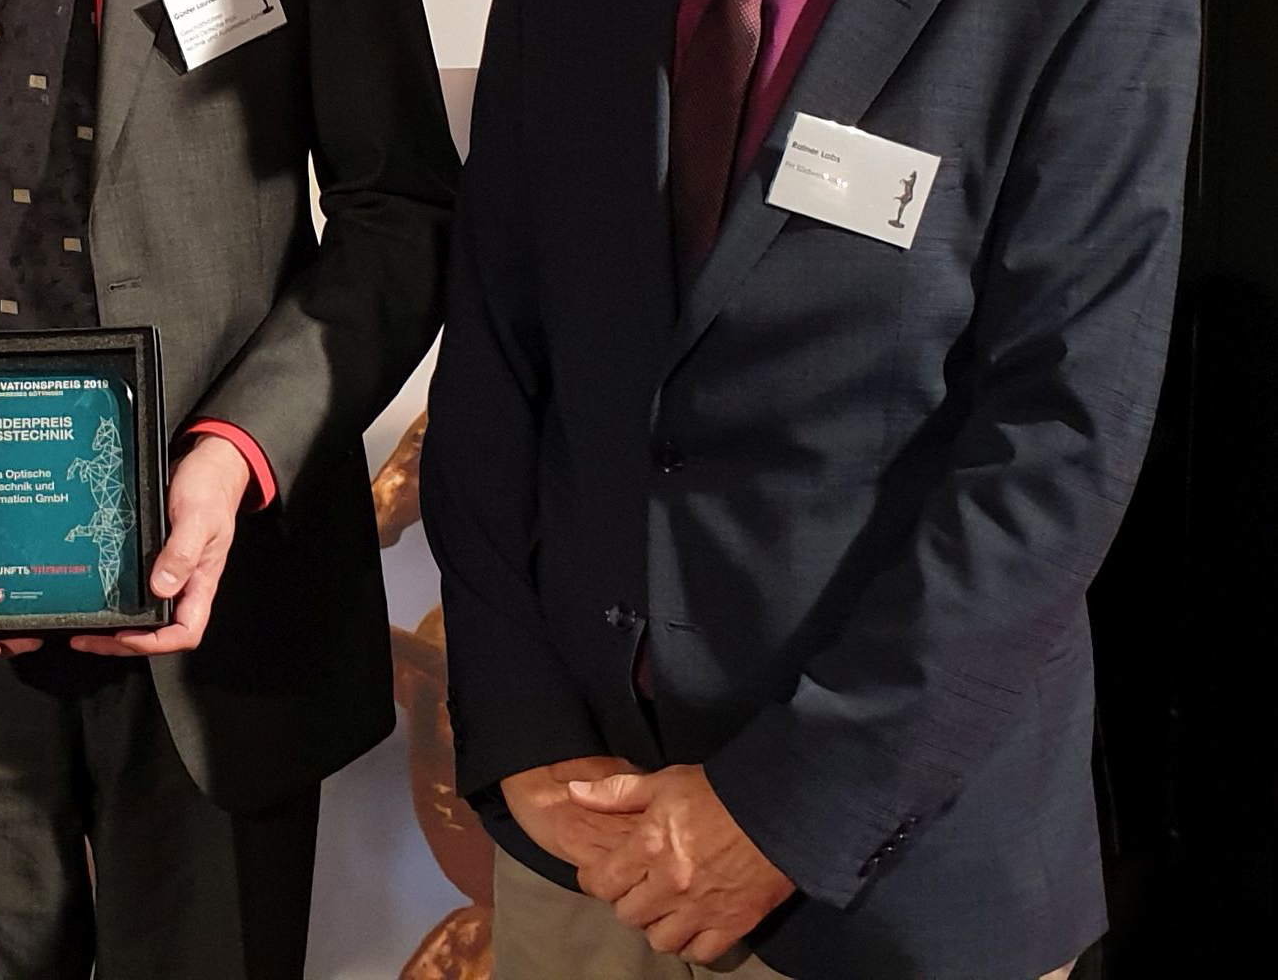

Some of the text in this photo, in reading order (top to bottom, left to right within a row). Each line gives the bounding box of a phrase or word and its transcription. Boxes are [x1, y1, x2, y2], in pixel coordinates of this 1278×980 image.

[5, 469, 52, 480] Optische
[35, 481, 55, 491] und
[35, 493, 69, 503] GmbH
